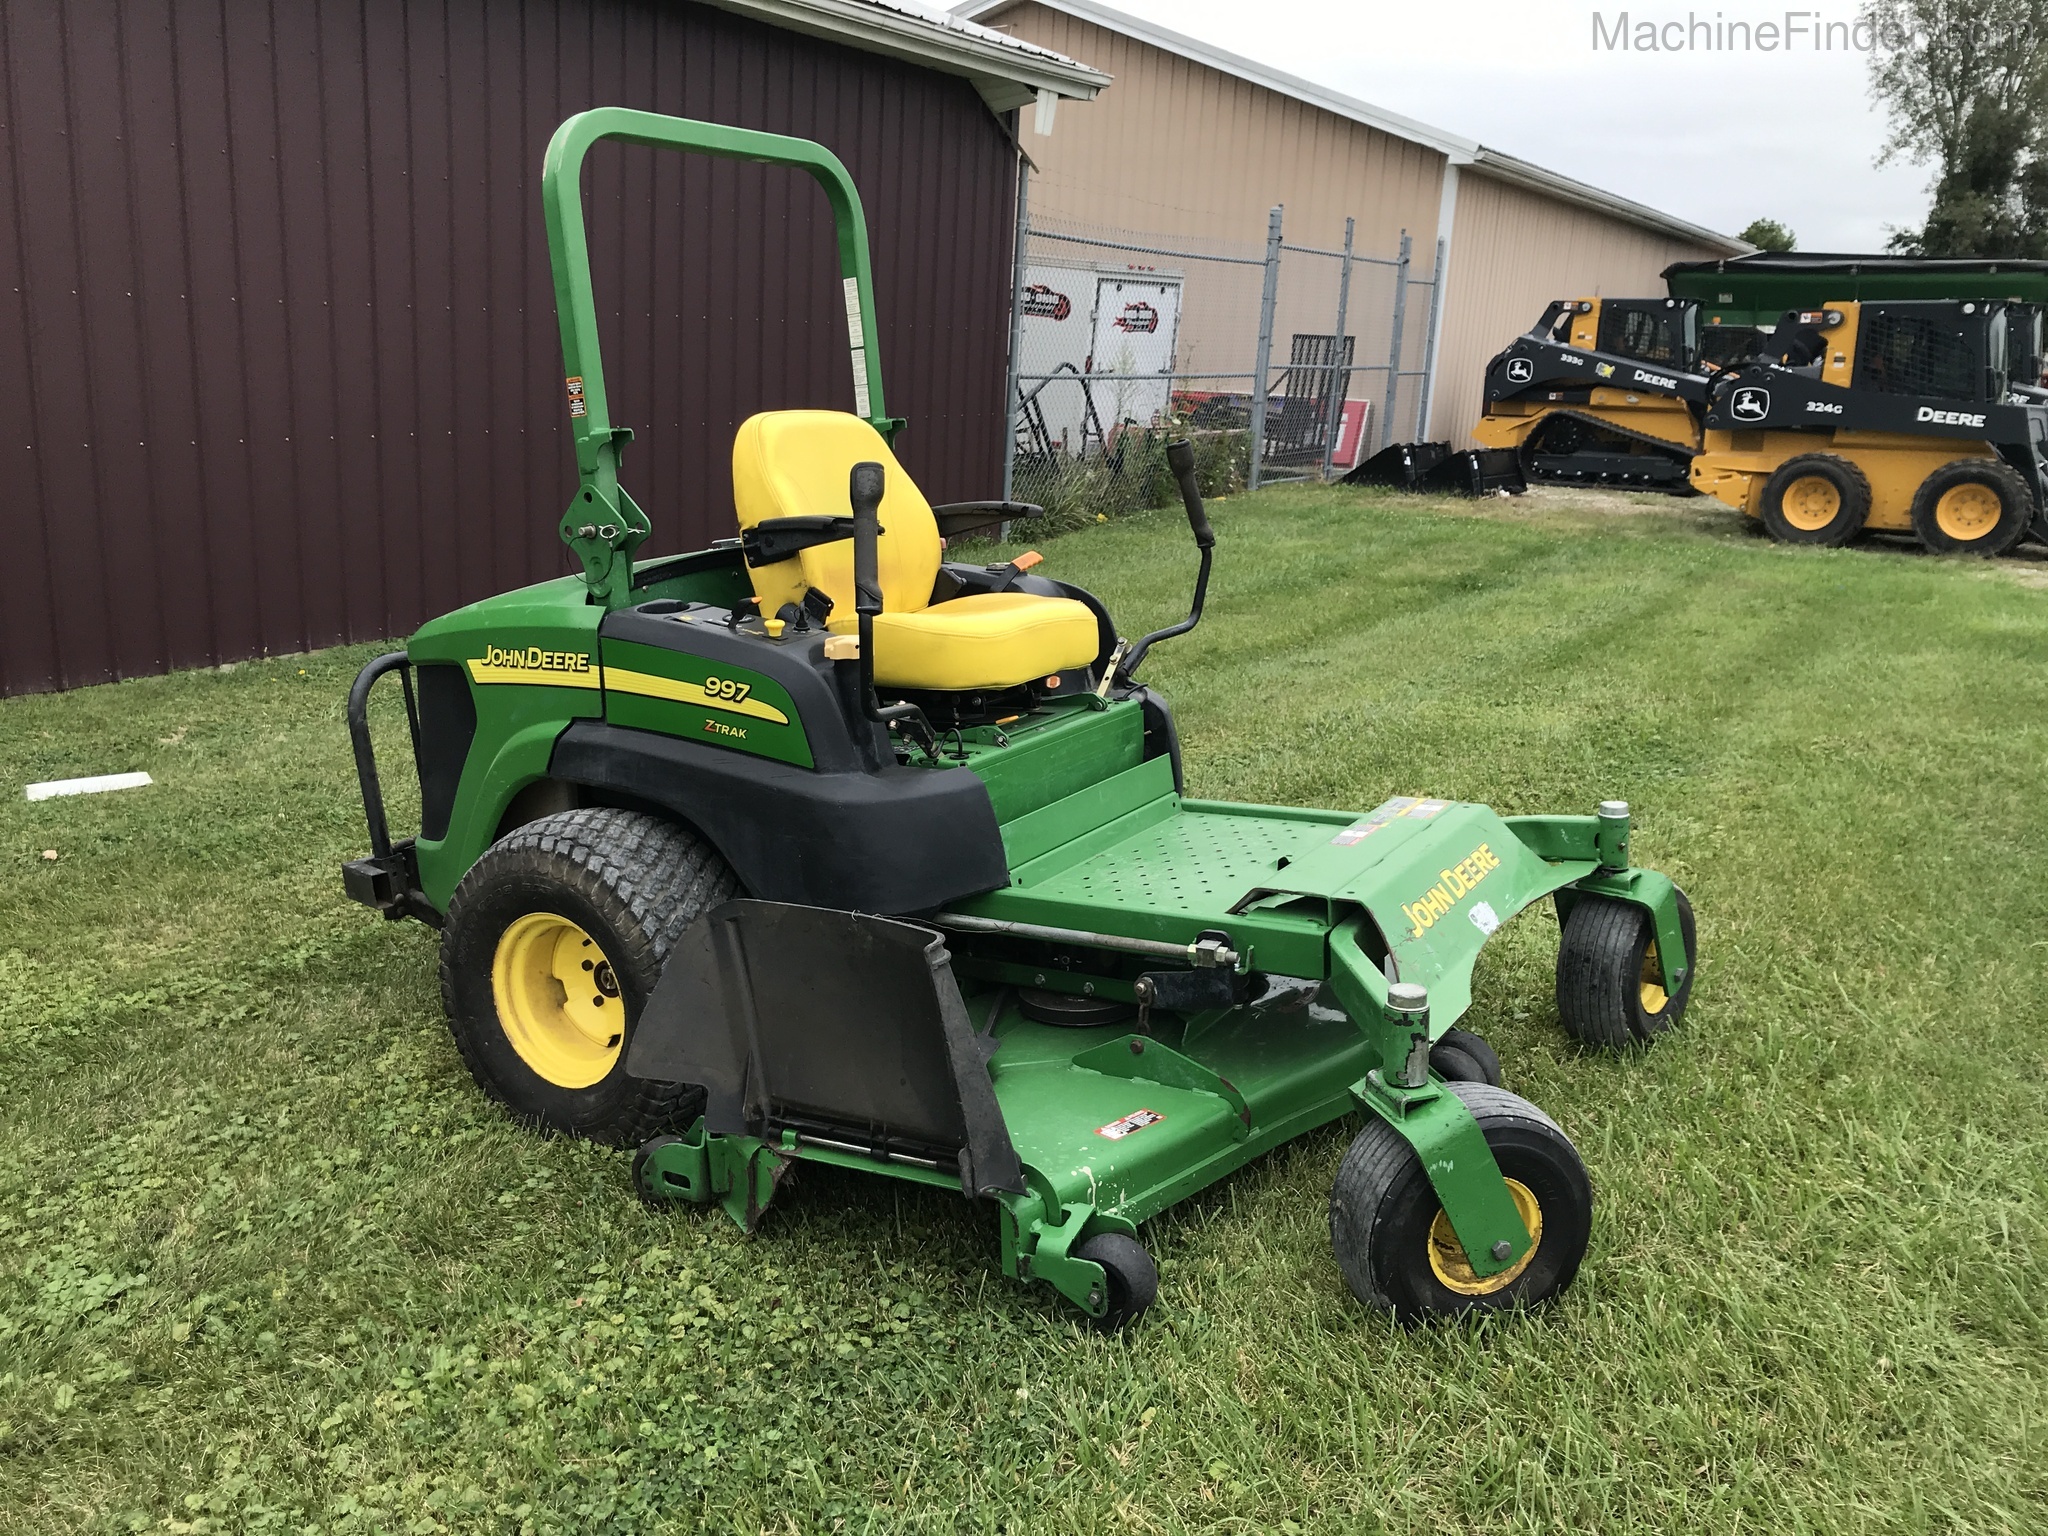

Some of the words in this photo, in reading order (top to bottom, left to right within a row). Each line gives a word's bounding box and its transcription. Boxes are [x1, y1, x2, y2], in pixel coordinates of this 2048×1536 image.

[1560, 353, 1584, 366] 333G
[1634, 369, 1678, 390] DEERE
[1806, 401, 1843, 415] 324G
[1917, 406, 1987, 428] DEERE
[481, 644, 527, 668] JOHN
[527, 646, 590, 672] DEERE
[704, 676, 752, 702] 997
[1400, 881, 1456, 938] JOHN
[1440, 842, 1501, 900] DEERE
